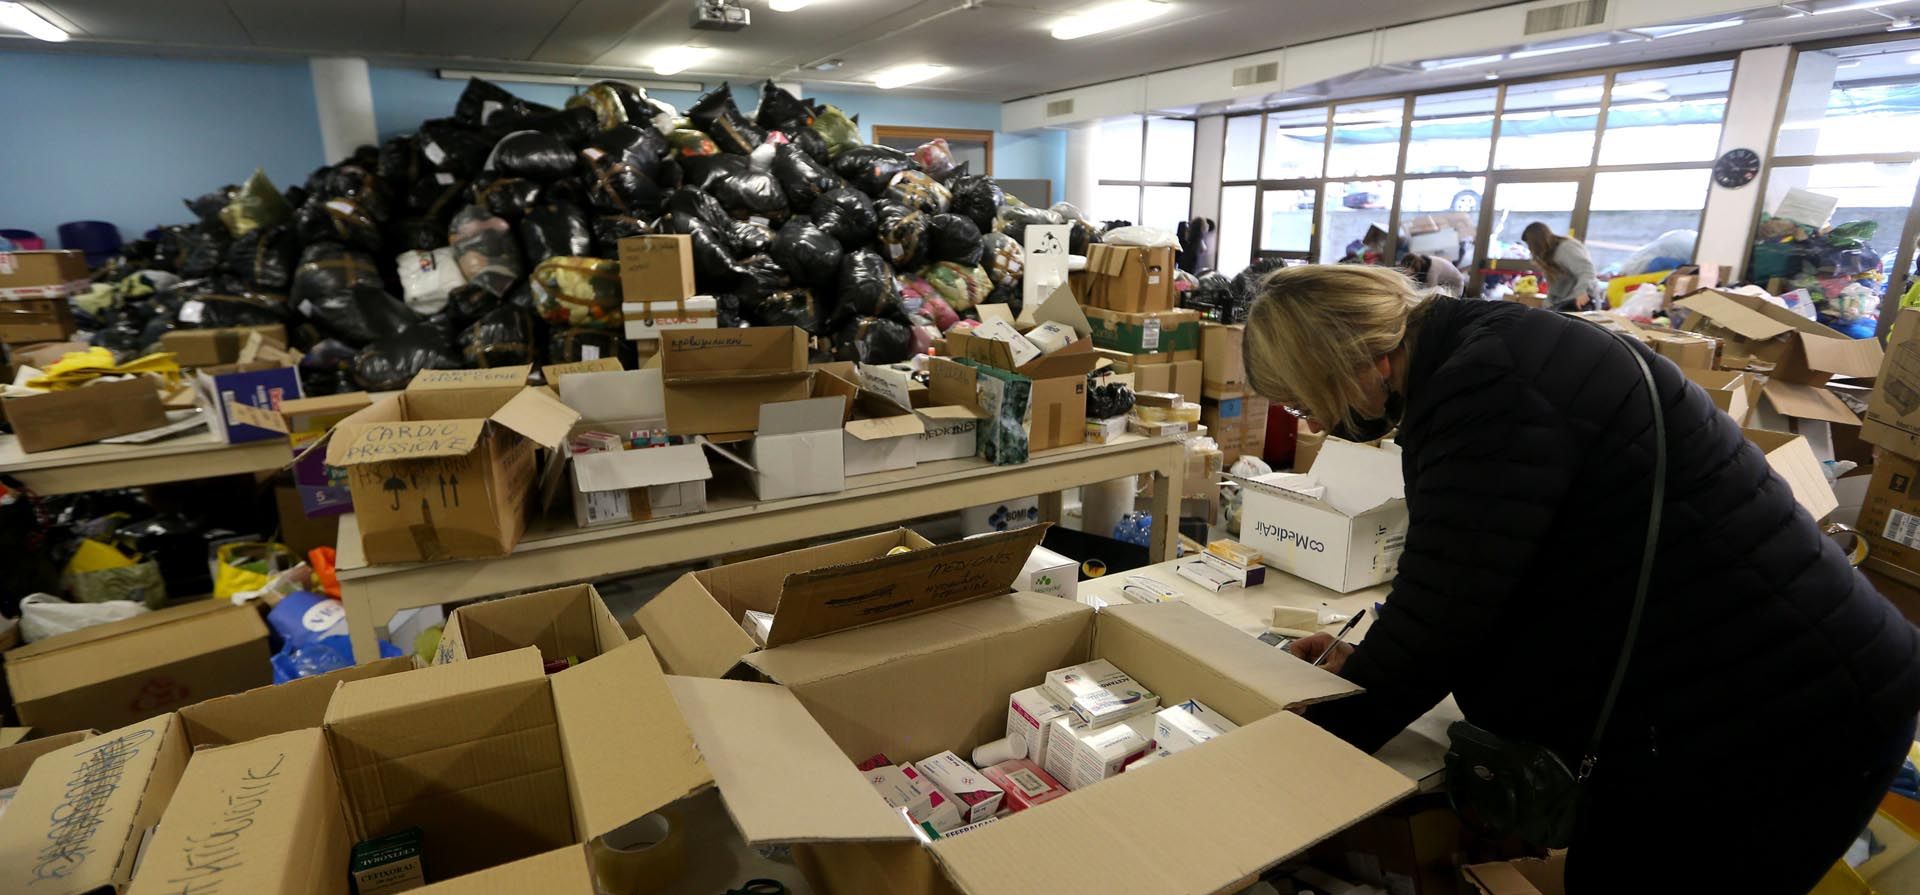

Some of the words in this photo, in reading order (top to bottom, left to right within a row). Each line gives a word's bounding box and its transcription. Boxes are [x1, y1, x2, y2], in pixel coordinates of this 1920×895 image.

[366, 425, 457, 443] CARDIO
[1255, 520, 1310, 551] MedicAir
[1099, 677, 1129, 688] ACETAMO
[360, 848, 416, 866] CEFIXORAL
